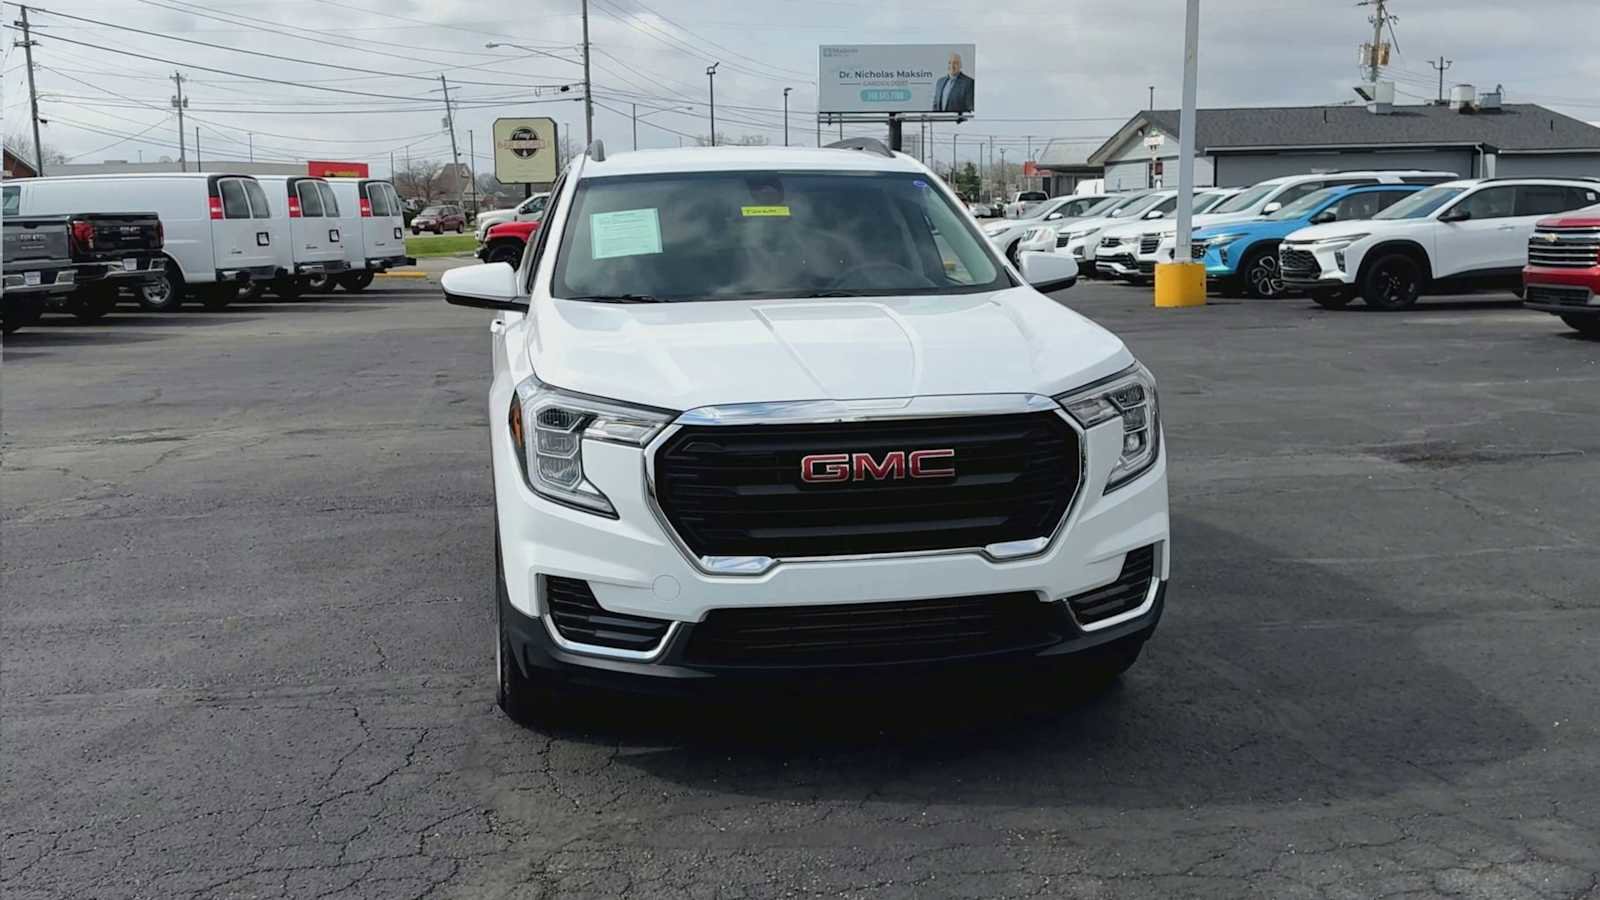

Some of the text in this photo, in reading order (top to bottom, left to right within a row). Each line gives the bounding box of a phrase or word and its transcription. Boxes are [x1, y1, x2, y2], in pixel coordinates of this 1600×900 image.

[839, 69, 933, 79] Dr. Nicholas Maksim
[801, 449, 955, 483] GMC
